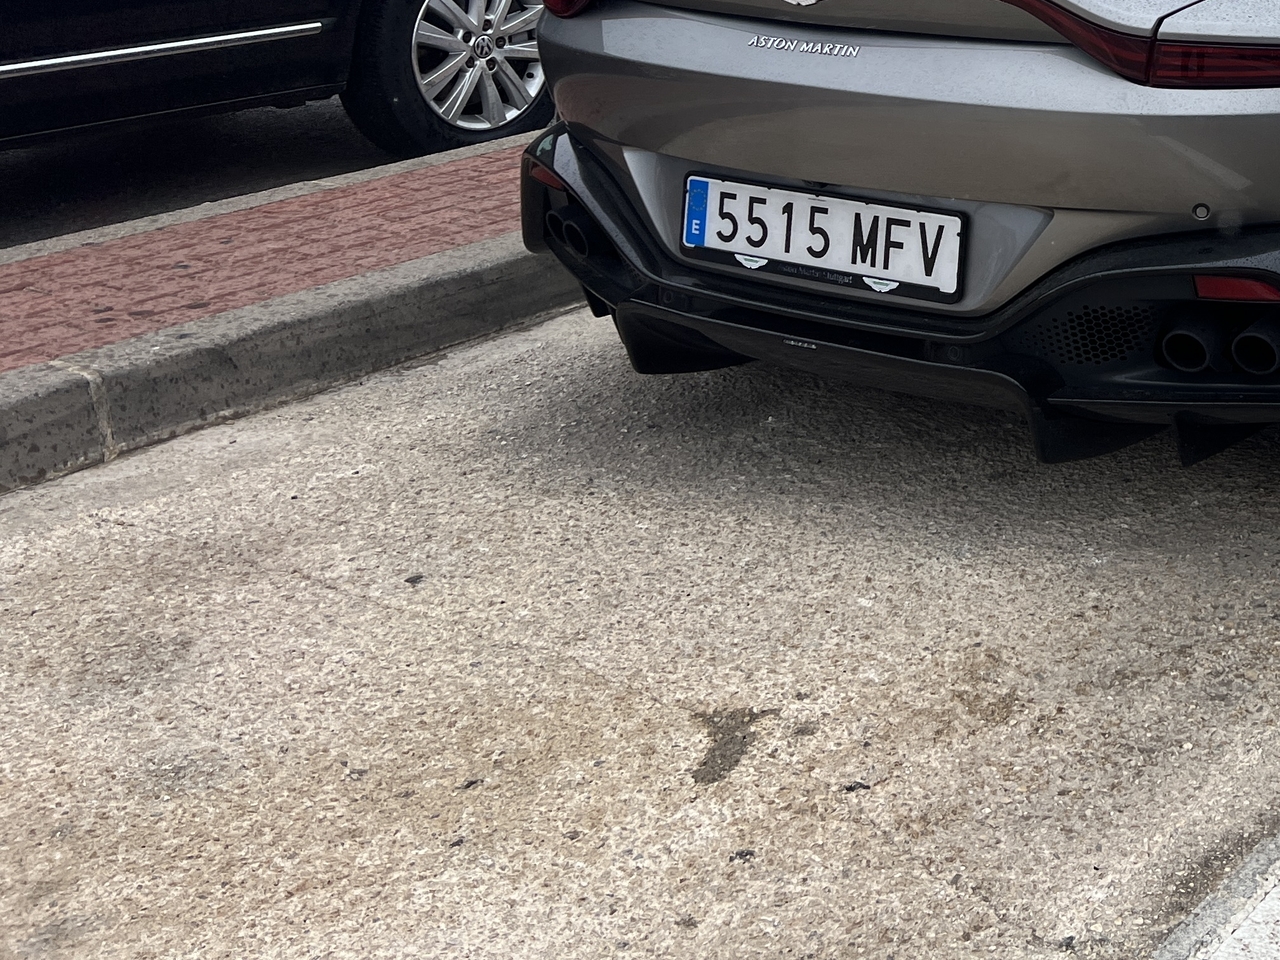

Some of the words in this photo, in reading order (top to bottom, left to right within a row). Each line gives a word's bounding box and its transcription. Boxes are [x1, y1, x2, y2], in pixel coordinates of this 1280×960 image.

[747, 35, 798, 52] ASTON
[800, 42, 860, 57] MARTIN
[691, 220, 700, 235] E
[716, 191, 830, 259] 5515
[851, 212, 945, 277] MFV
